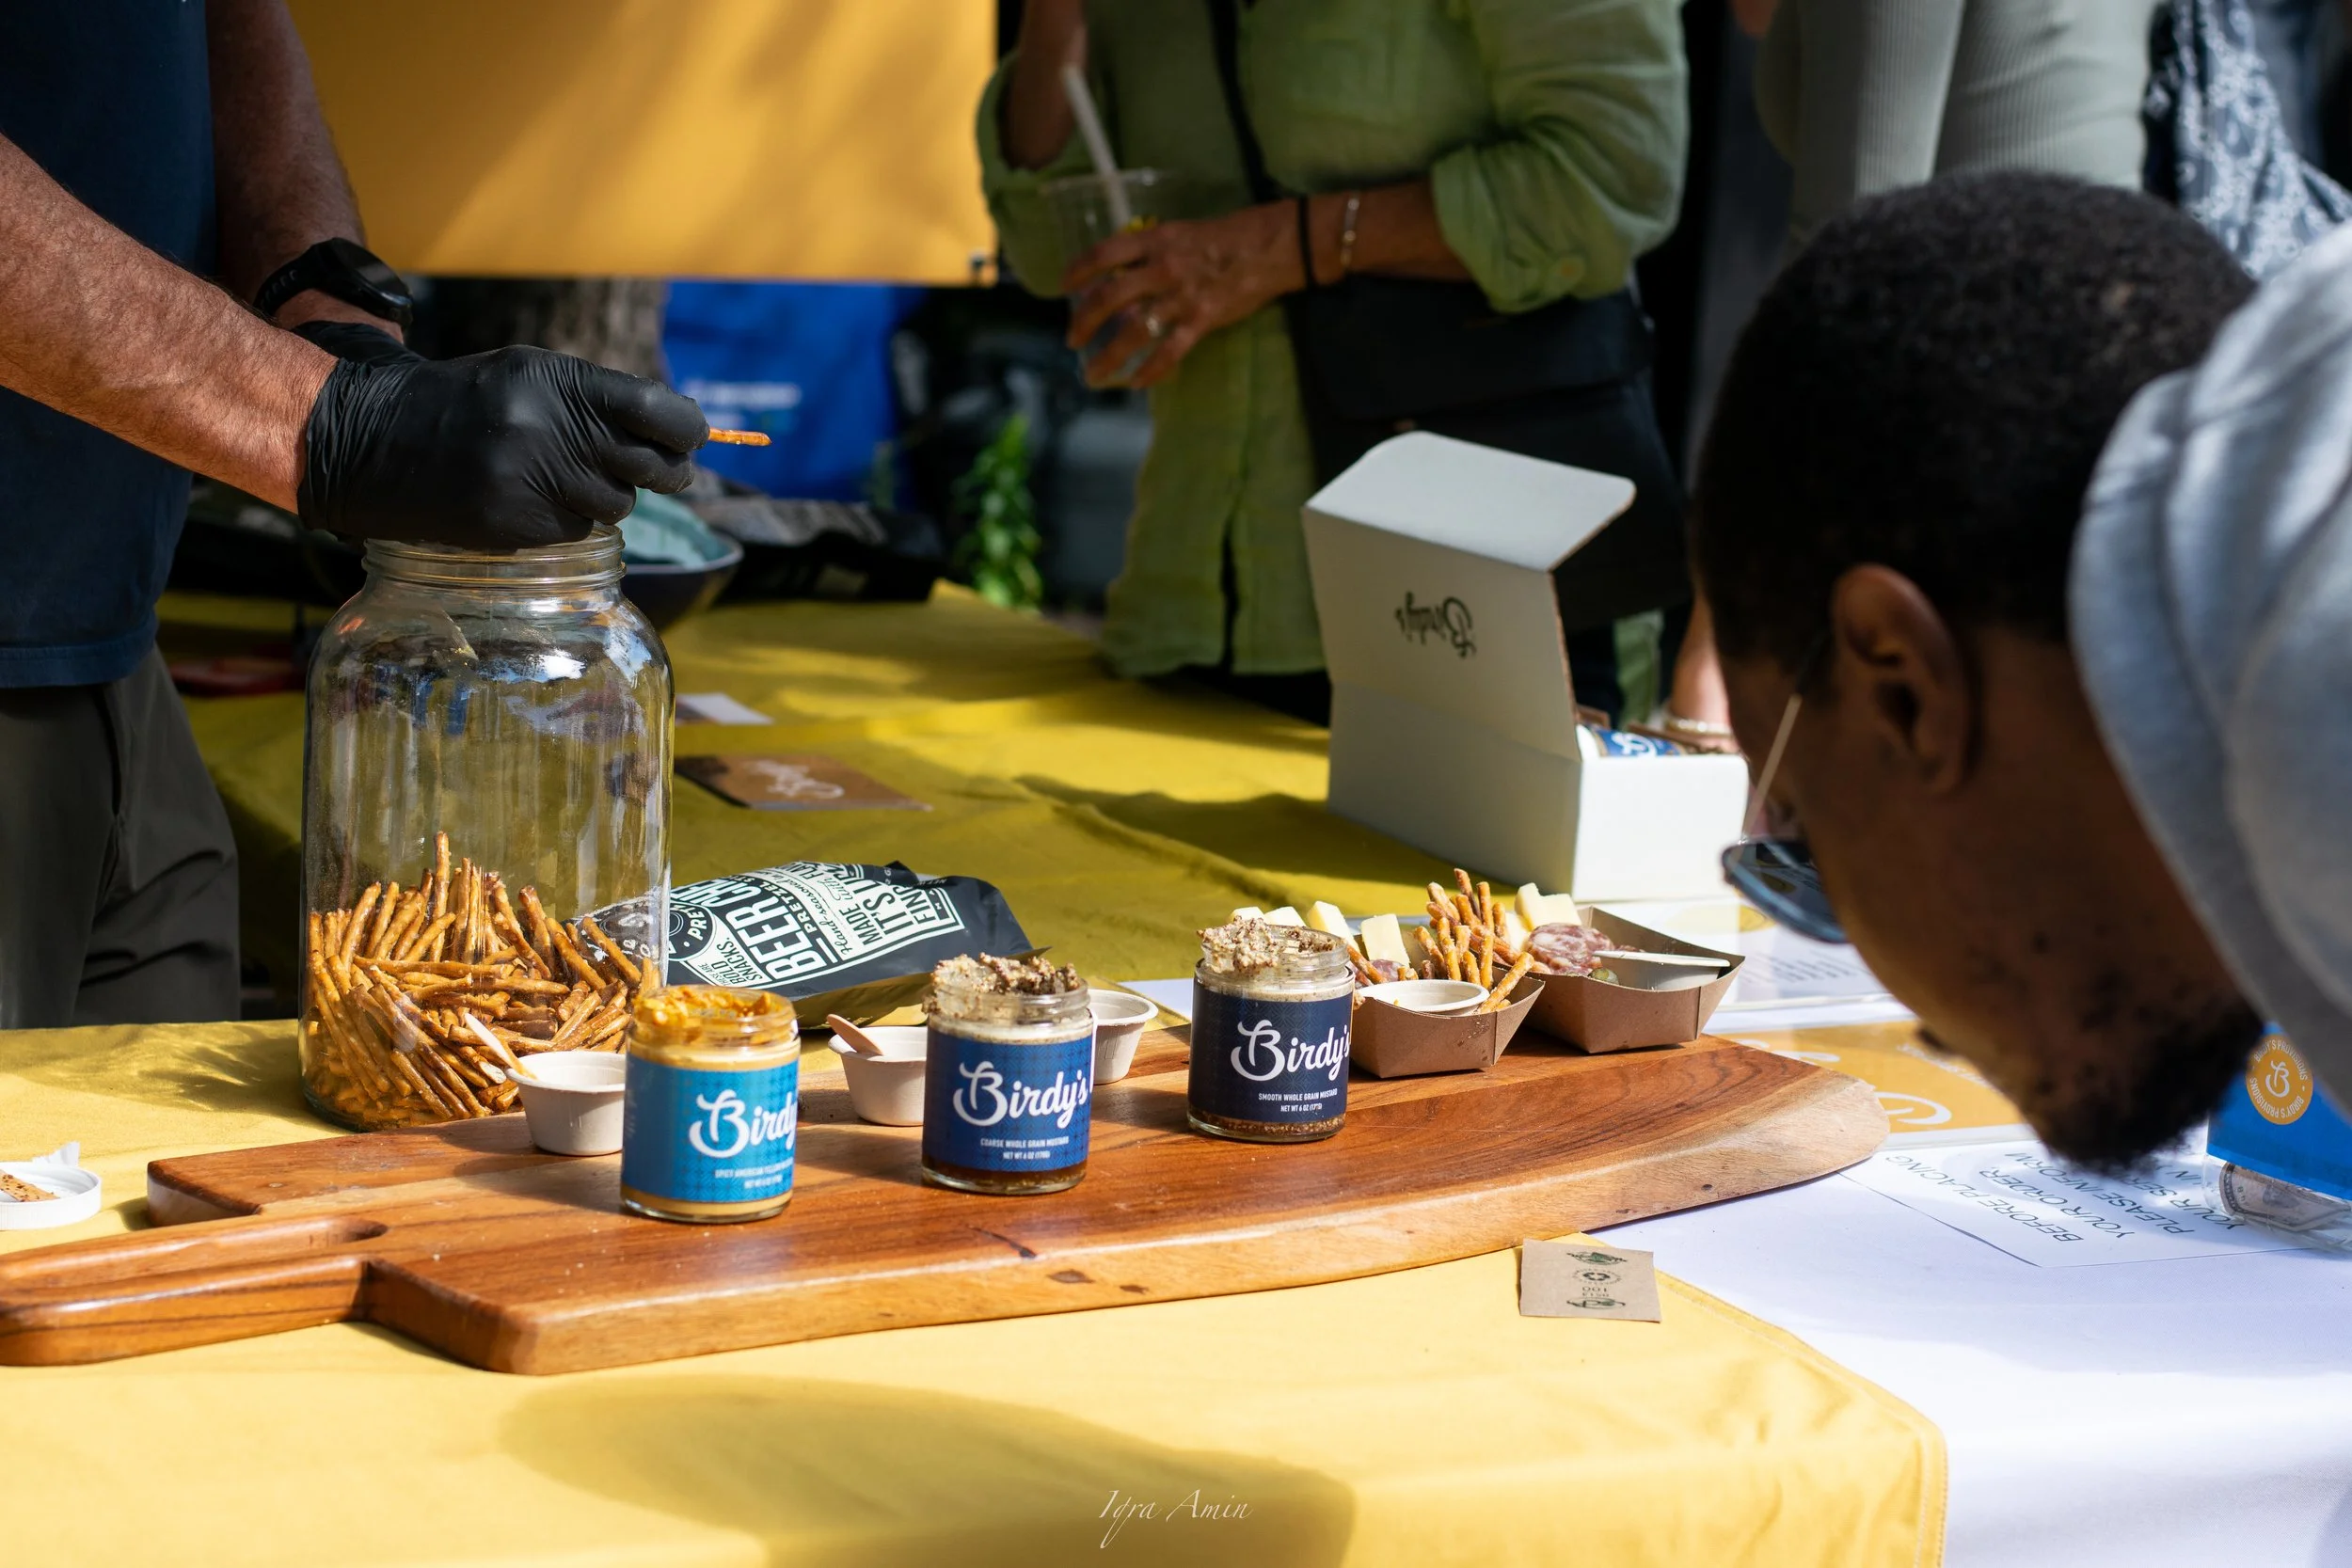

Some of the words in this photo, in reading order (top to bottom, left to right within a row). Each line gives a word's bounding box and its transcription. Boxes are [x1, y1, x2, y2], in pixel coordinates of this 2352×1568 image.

[758, 880, 818, 934] PRETZEL
[839, 903, 884, 946] MADE
[863, 893, 914, 935] IT'S
[725, 895, 828, 980] BEER
[711, 960, 748, 985] BOLD
[716, 937, 763, 981] SNACKS.
[1231, 1020, 1350, 1082] Birdy's
[953, 1061, 1089, 1129] Birdy's
[1258, 1092, 1282, 1101] SMOOTH
[1283, 1093, 1303, 1101] WHOLE
[1303, 1091, 1320, 1101] GRAIN
[2249, 1077, 2280, 1118] PROVISIONS
[1884, 1154, 1991, 1198] PLACING
[2004, 1152, 2105, 1193] INFORM
[1977, 1198, 2085, 1243] BEFORE
[2060, 1205, 2136, 1239] YOUR
[2091, 1192, 2195, 1234] PLEASE
[2169, 1197, 2246, 1230] YOUR
